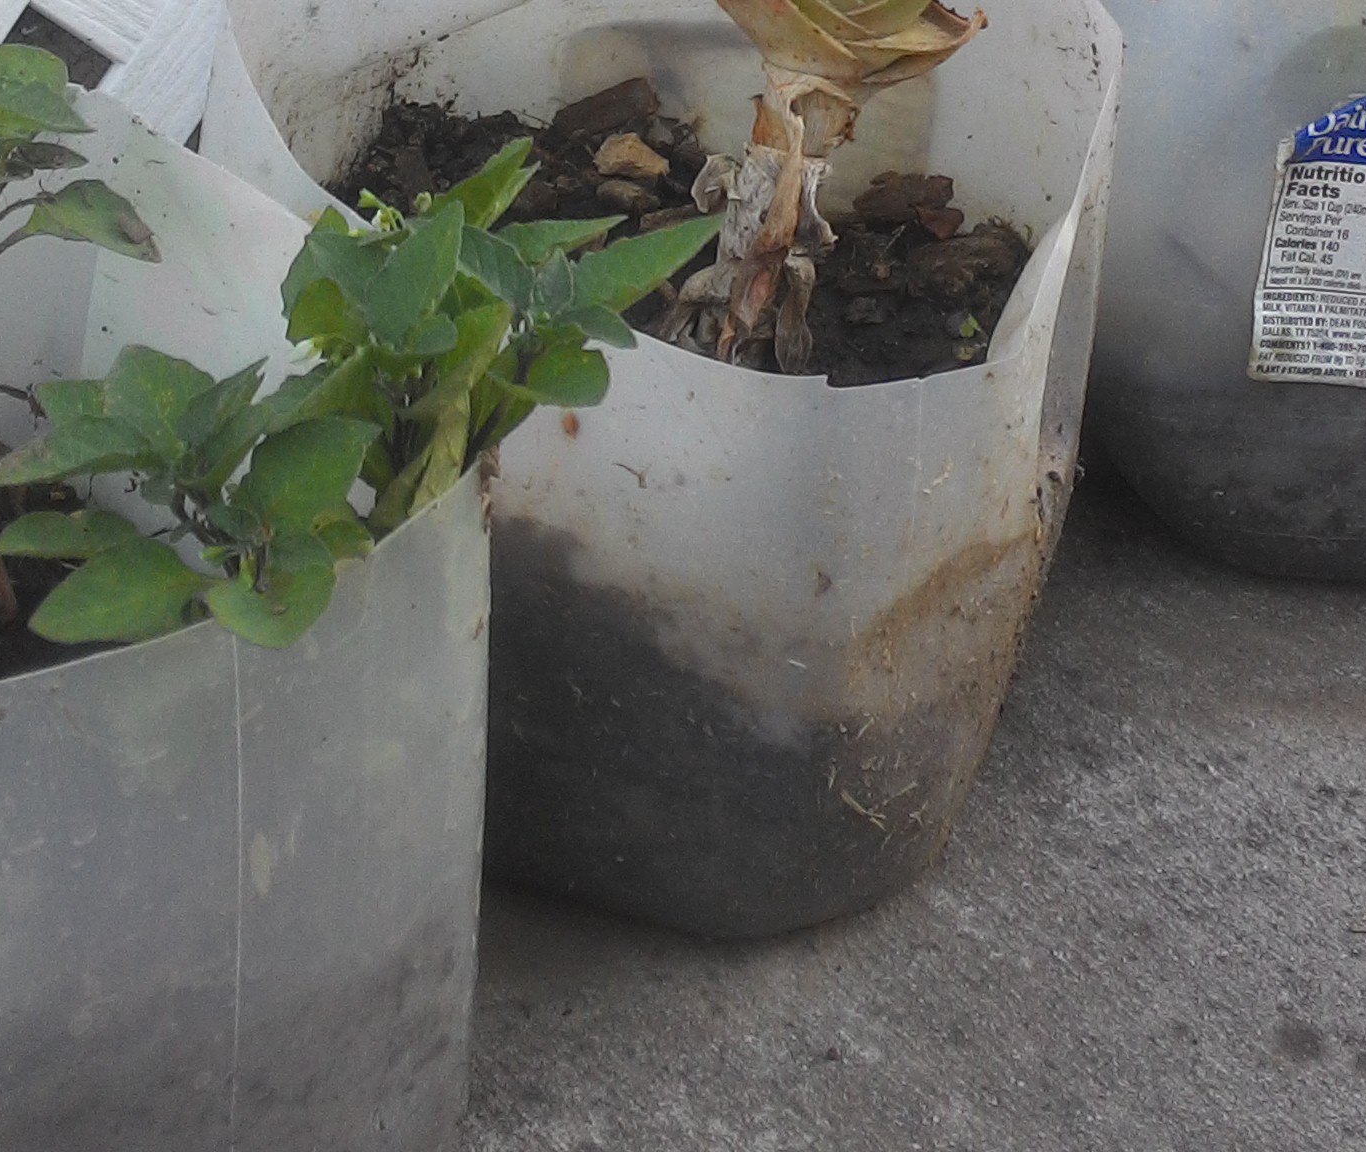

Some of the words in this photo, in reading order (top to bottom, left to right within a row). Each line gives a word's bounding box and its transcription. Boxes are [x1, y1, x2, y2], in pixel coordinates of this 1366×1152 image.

[1285, 180, 1341, 199] Facts
[1301, 198, 1319, 210] Size
[1326, 200, 1343, 214] Cup
[1278, 210, 1321, 225] Servings
[1323, 213, 1342, 225] Per
[1284, 223, 1333, 238] Container
[1336, 228, 1349, 240] 16
[1274, 236, 1317, 250] Calories
[1320, 240, 1340, 252] 140
[1280, 249, 1297, 262] Fat
[1297, 250, 1317, 263] Cal.
[1319, 253, 1333, 265] 45
[1262, 291, 1318, 302] INGREDIENTS:
[1319, 293, 1358, 306] REDUCED
[1284, 302, 1316, 312] VITAMIN
[1317, 303, 1323, 313] A
[1262, 314, 1313, 326] DISTRIBUTED
[1314, 316, 1328, 326] BY:
[1329, 317, 1350, 327] DEAN
[1294, 327, 1304, 336] TX
